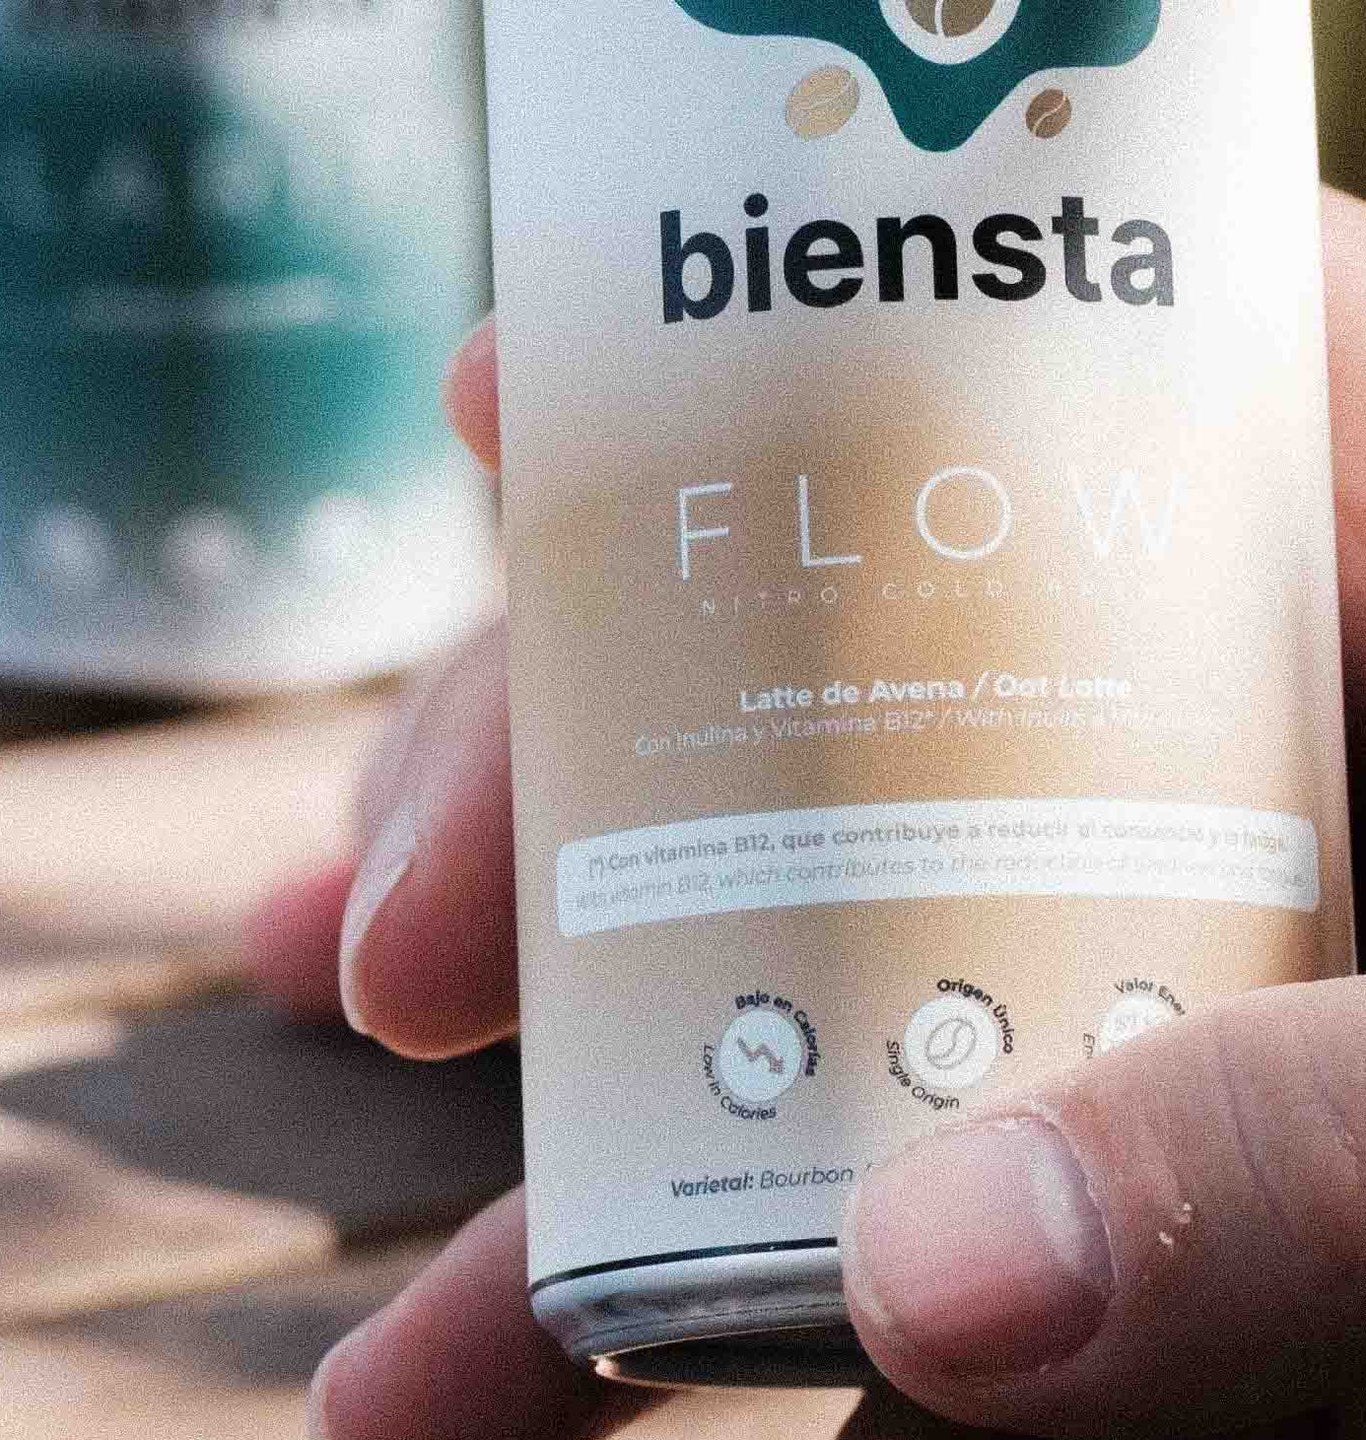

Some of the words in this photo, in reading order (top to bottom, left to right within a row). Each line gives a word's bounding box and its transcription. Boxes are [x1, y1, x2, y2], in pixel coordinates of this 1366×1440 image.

[660, 193, 1175, 324] biensta
[676, 464, 1189, 580] FLOW
[740, 685, 812, 712] Latte
[823, 680, 859, 705] de
[869, 677, 965, 702] Avena
[995, 673, 1049, 697] Oat
[1059, 672, 1133, 698] Latte
[634, 733, 671, 756] Con
[677, 723, 747, 751] Inulina
[770, 714, 876, 738] Vitamina
[609, 852, 640, 871] Con
[645, 840, 729, 865] vitamina
[734, 833, 776, 855] B12,
[782, 829, 826, 853] que
[832, 821, 960, 845] contribuye
[968, 824, 981, 839] a
[719, 867, 782, 889] which
[786, 857, 915, 883] contributes
[921, 857, 944, 875] to
[735, 989, 771, 1009] Bajo
[773, 996, 794, 1012] en
[1113, 977, 1155, 993] Valor
[937, 978, 993, 1006] Origen
[993, 1003, 1015, 1054] Único
[703, 1043, 715, 1079] Low
[721, 1096, 777, 1120] Calories
[886, 1039, 912, 1088] Single
[912, 1085, 961, 1110] Origin
[670, 1171, 754, 1197] Varietal:
[760, 1166, 855, 1189] Bourbon
